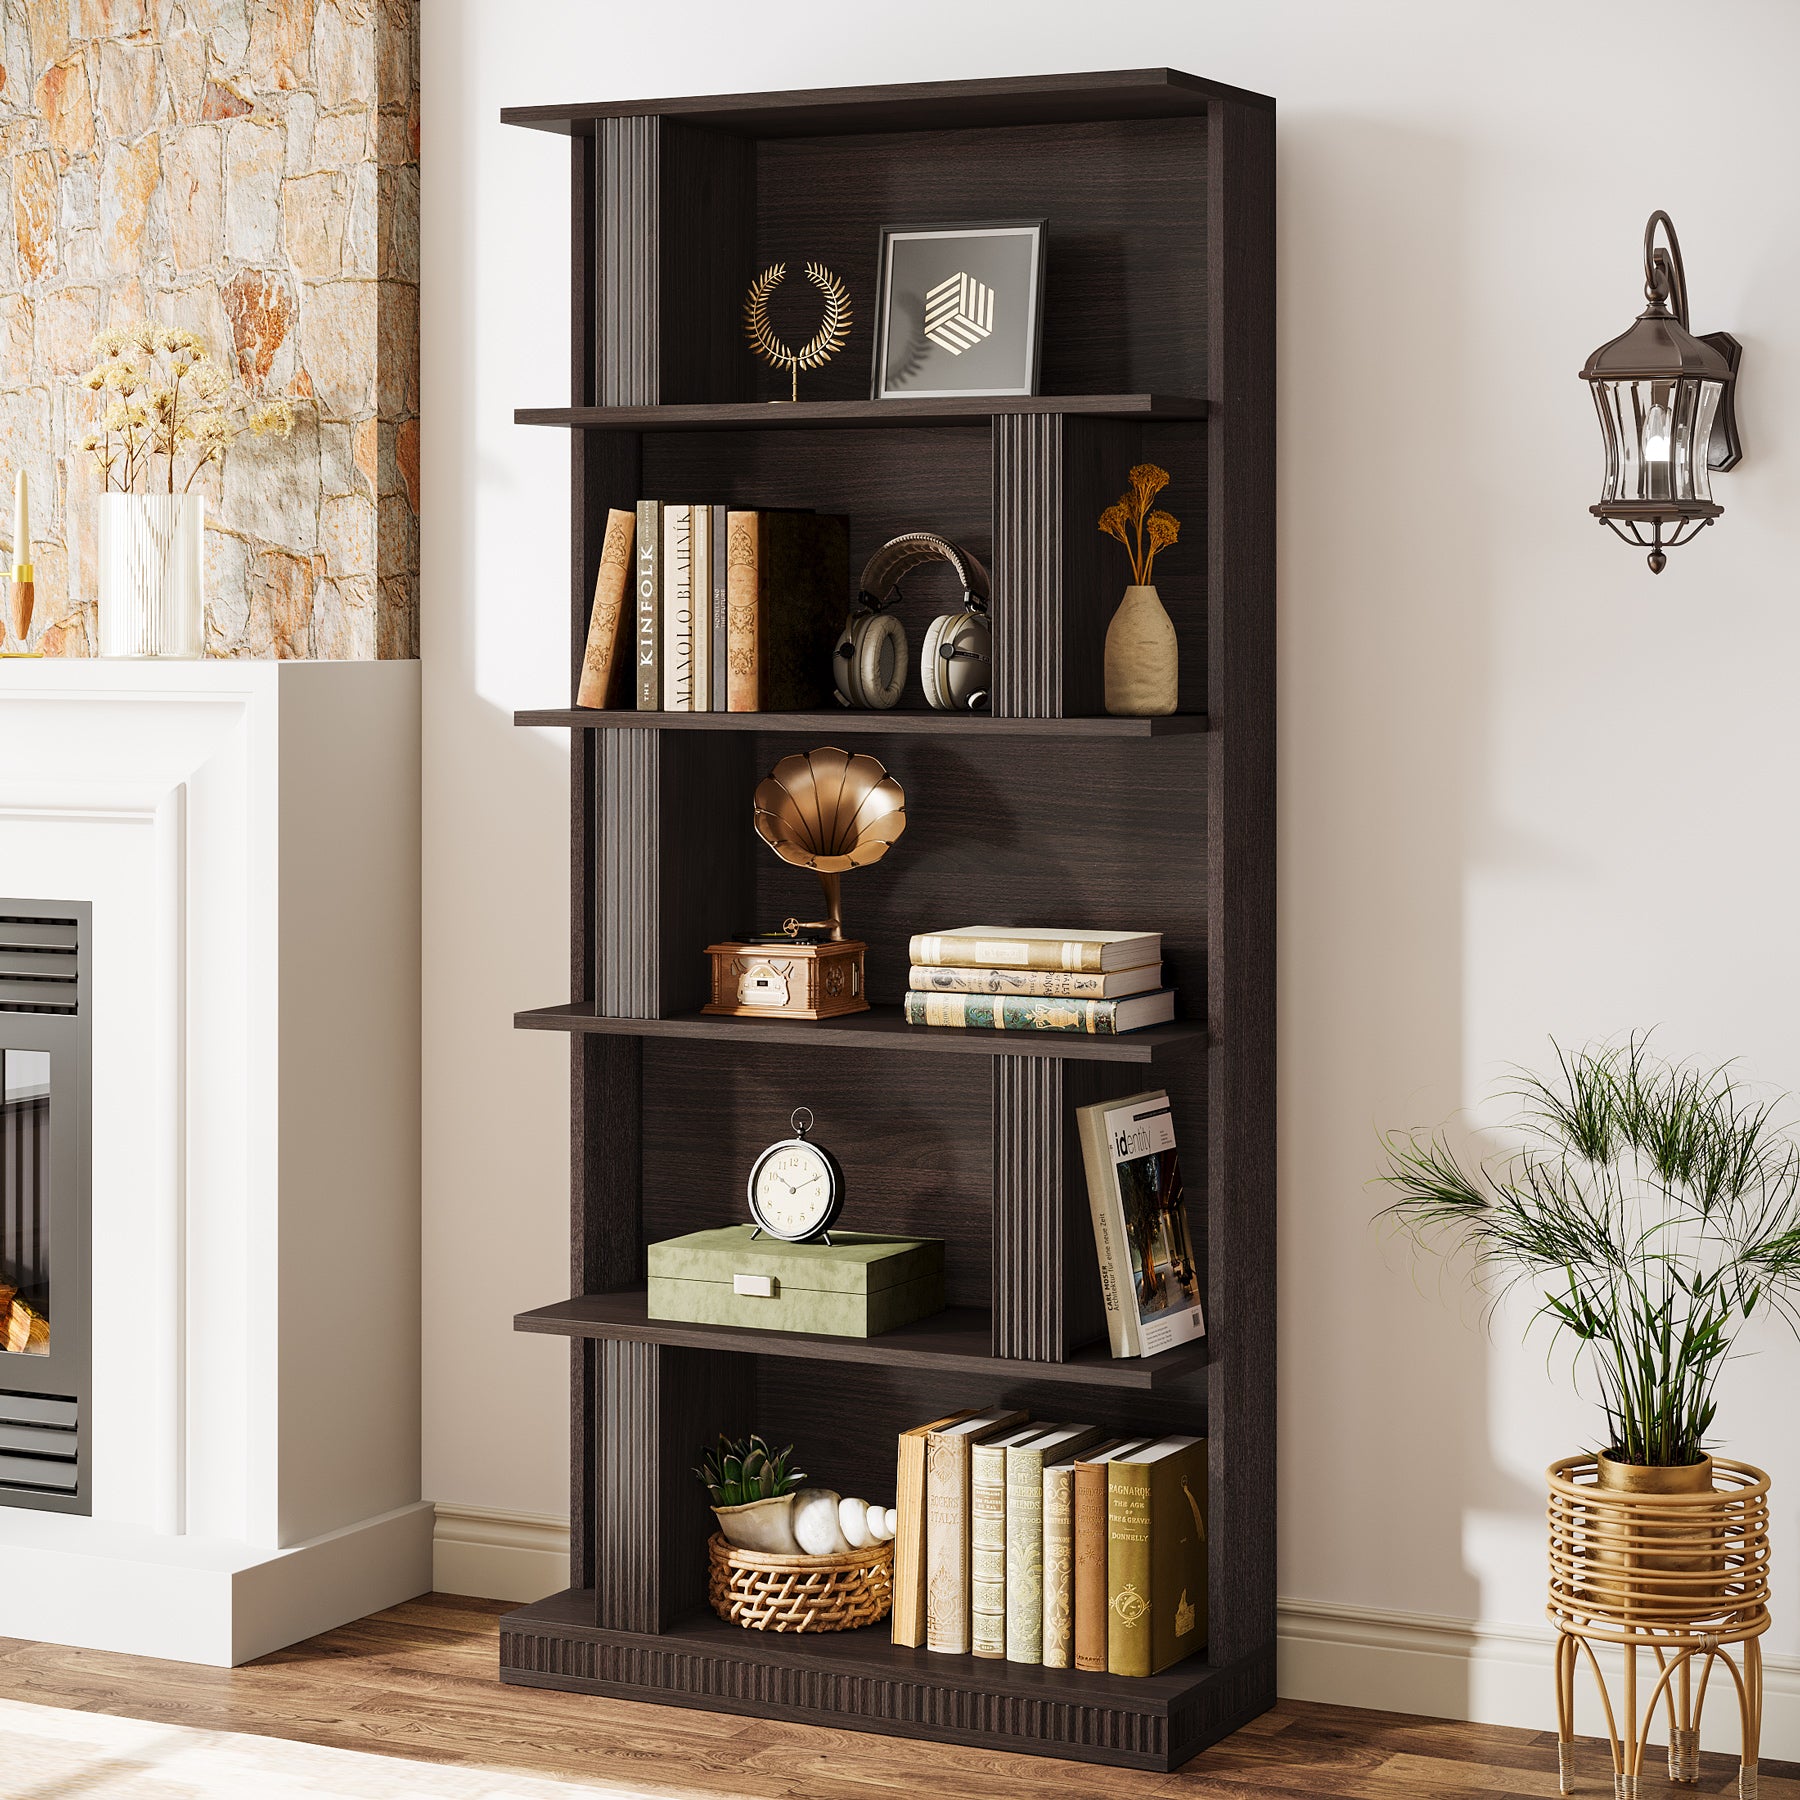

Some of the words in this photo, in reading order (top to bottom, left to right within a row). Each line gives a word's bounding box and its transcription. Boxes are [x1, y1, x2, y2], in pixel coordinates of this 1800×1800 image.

[673, 512, 691, 599] BLAHNÍK
[640, 544, 653, 666] KINFOLK
[676, 609, 693, 705] MANOLO
[1114, 1125, 1151, 1157] identity
[778, 1161, 786, 1170] 11
[789, 1158, 798, 1167] 12
[769, 1172, 778, 1181] 10
[815, 1187, 820, 1196] 3
[800, 1212, 805, 1221] 5
[1102, 1265, 1110, 1290] MOSER
[1105, 1292, 1114, 1311] CARL
[1113, 1500, 1127, 1508] THE
[1112, 1532, 1149, 1542] DONNELLY
